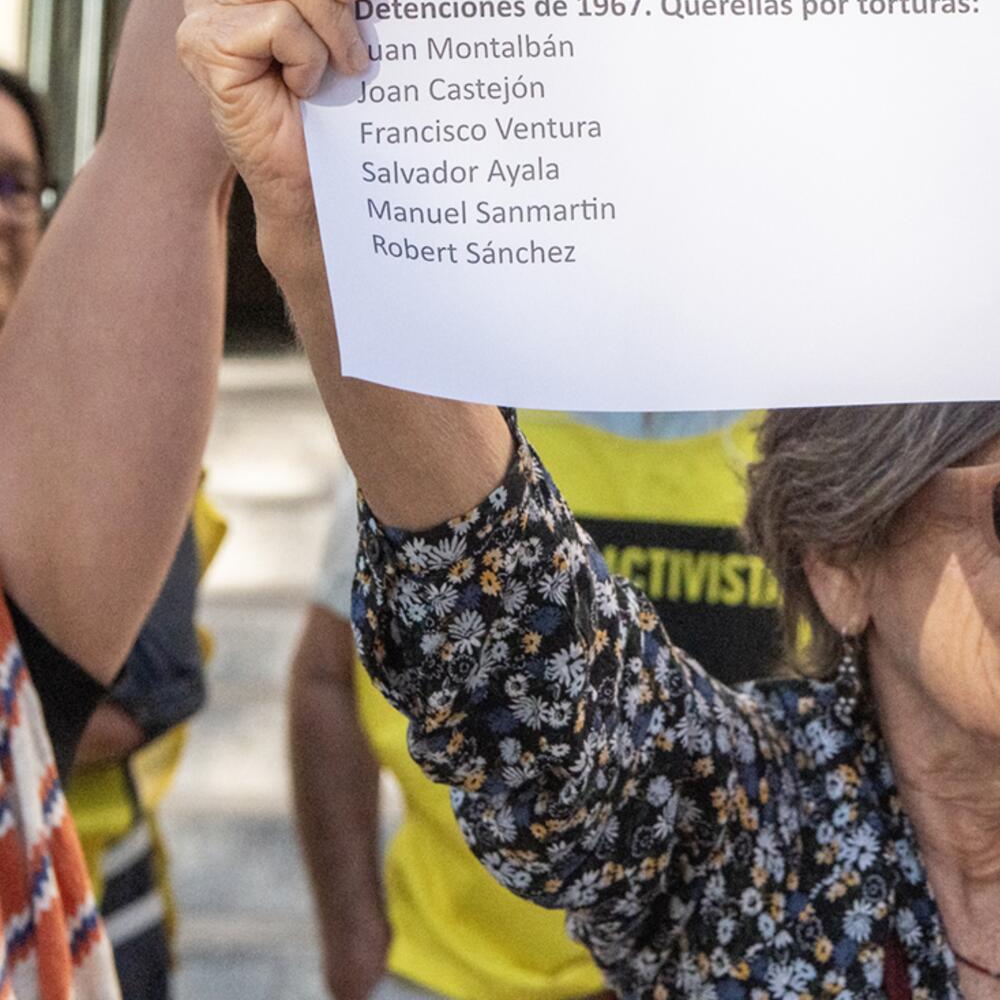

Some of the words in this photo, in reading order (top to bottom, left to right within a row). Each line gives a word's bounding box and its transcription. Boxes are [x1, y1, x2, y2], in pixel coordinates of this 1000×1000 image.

[367, 42, 417, 62] uan
[427, 33, 574, 60] Montalbán
[357, 80, 419, 104] Joan
[429, 74, 545, 105] Castejón
[360, 119, 487, 145] Francisco
[494, 117, 602, 141] Ventura
[361, 159, 479, 185] Salvador
[487, 156, 560, 188] Ayala
[367, 198, 467, 225] Manuel
[372, 234, 459, 264] Robert
[466, 239, 576, 265] Sánchez
